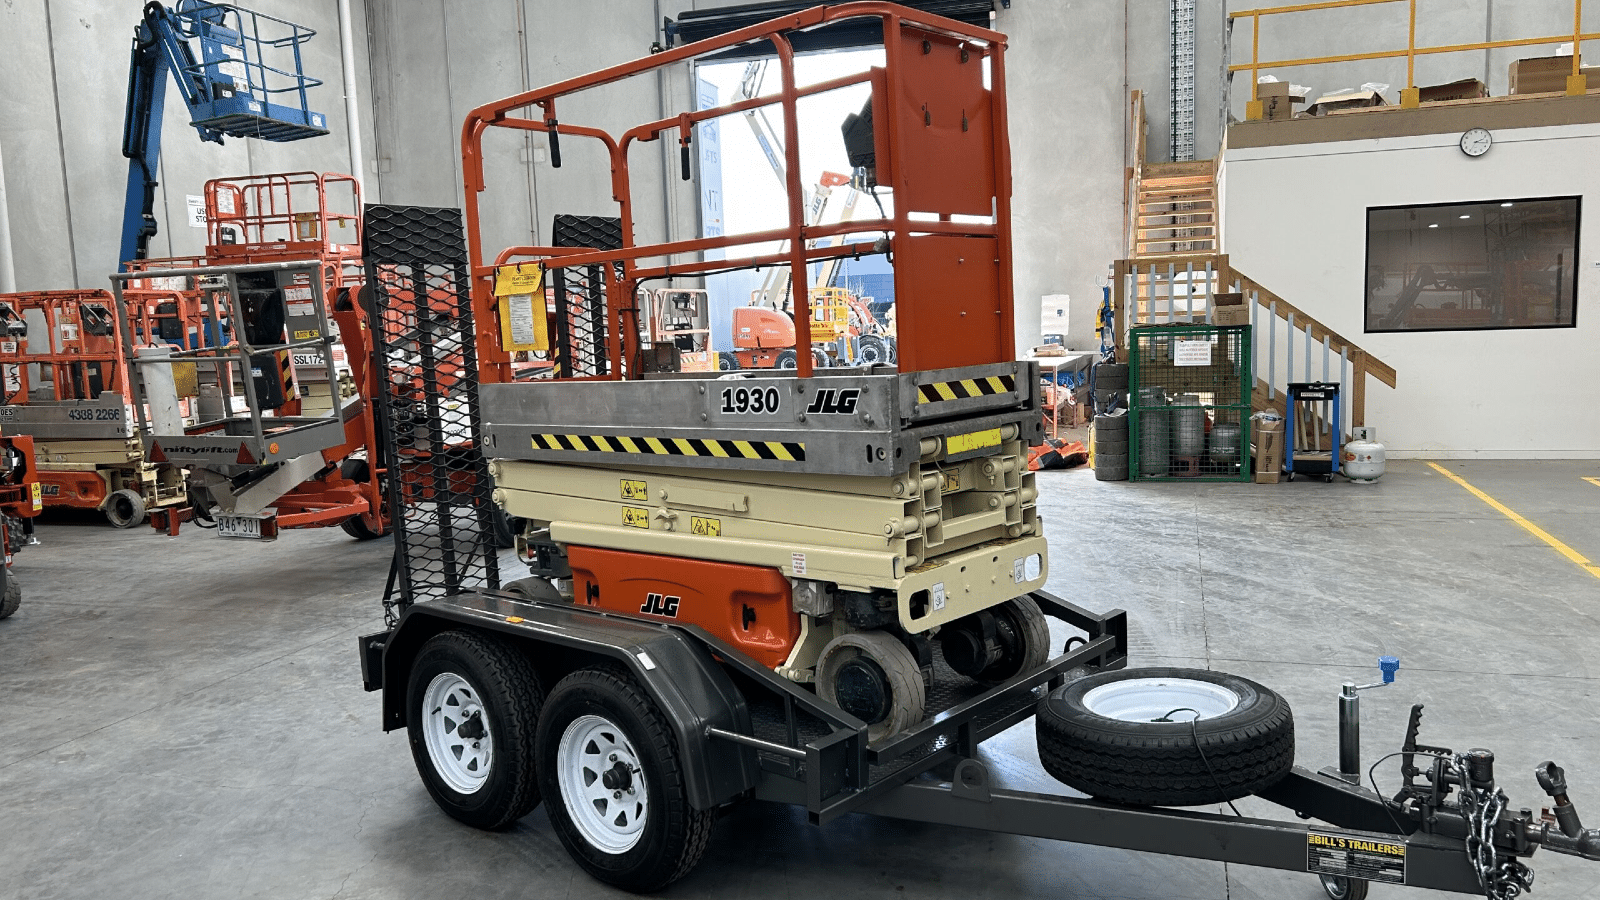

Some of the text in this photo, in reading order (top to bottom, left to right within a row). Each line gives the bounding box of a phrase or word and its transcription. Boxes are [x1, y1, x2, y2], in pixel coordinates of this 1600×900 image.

[721, 386, 781, 415] 1930
[805, 388, 862, 416] JLG
[96, 408, 120, 420] 2266
[163, 445, 239, 455] niftylift.com
[218, 517, 260, 534] B46 301
[640, 592, 682, 619] JLG
[1314, 835, 1346, 848] BILL'S
[1347, 840, 1399, 855] TRAILERS
